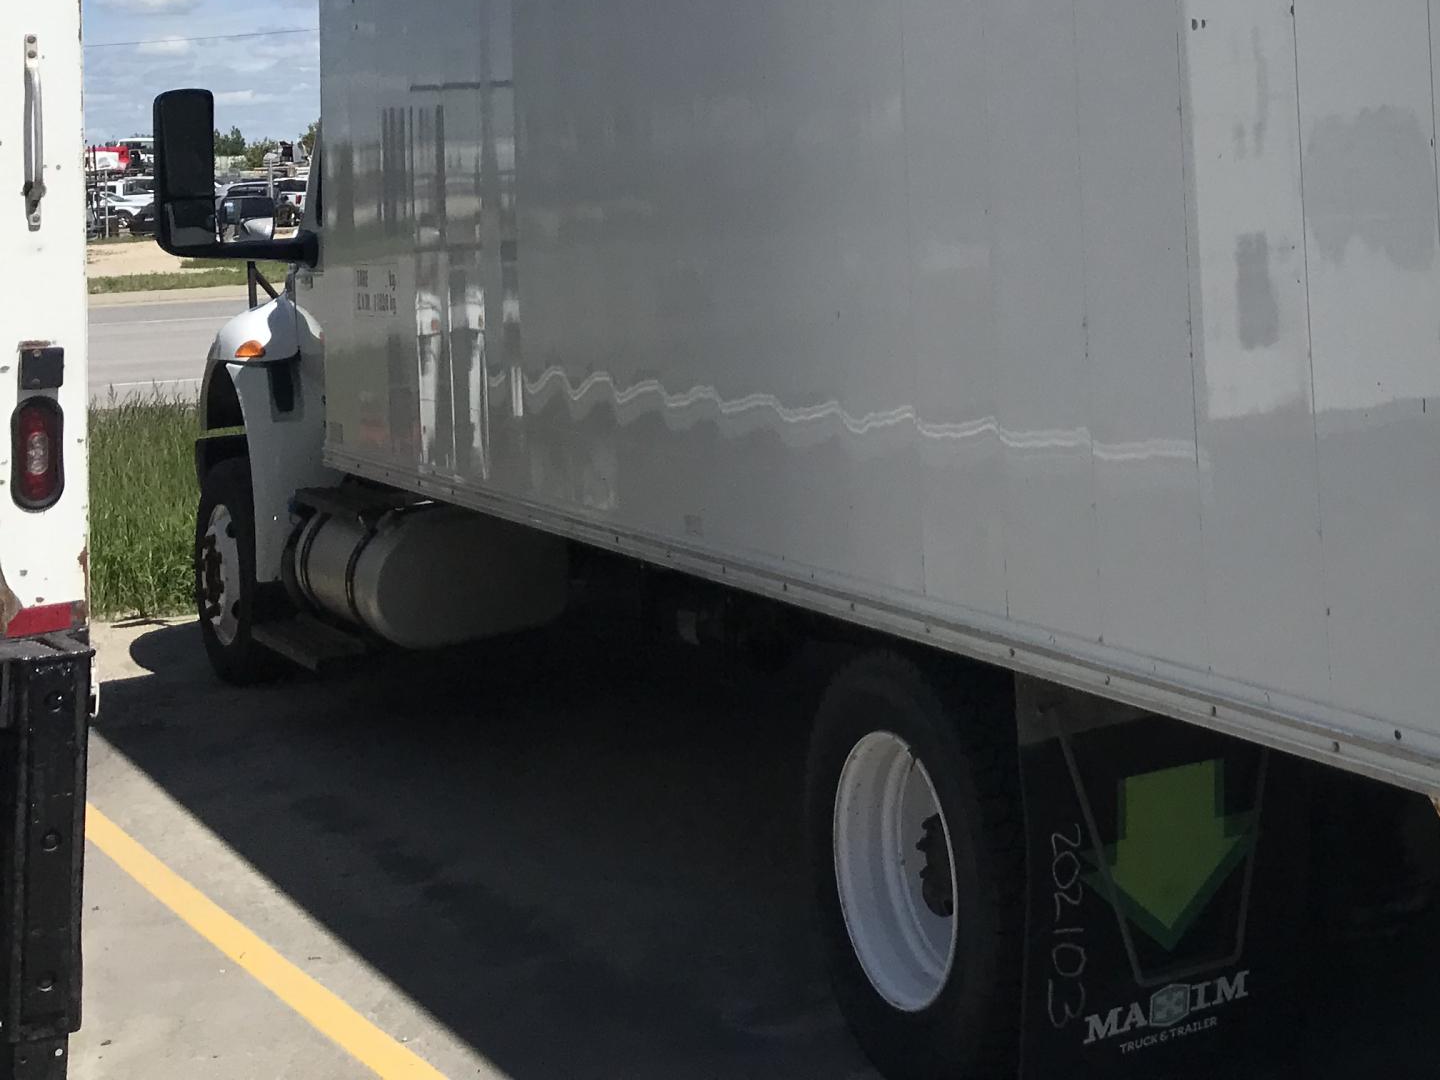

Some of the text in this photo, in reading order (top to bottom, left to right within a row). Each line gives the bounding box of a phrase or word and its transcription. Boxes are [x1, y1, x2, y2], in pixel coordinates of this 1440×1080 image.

[1048, 823, 1087, 1029] 202103
[1120, 1016, 1218, 1054] TRUCK & TRAILER
